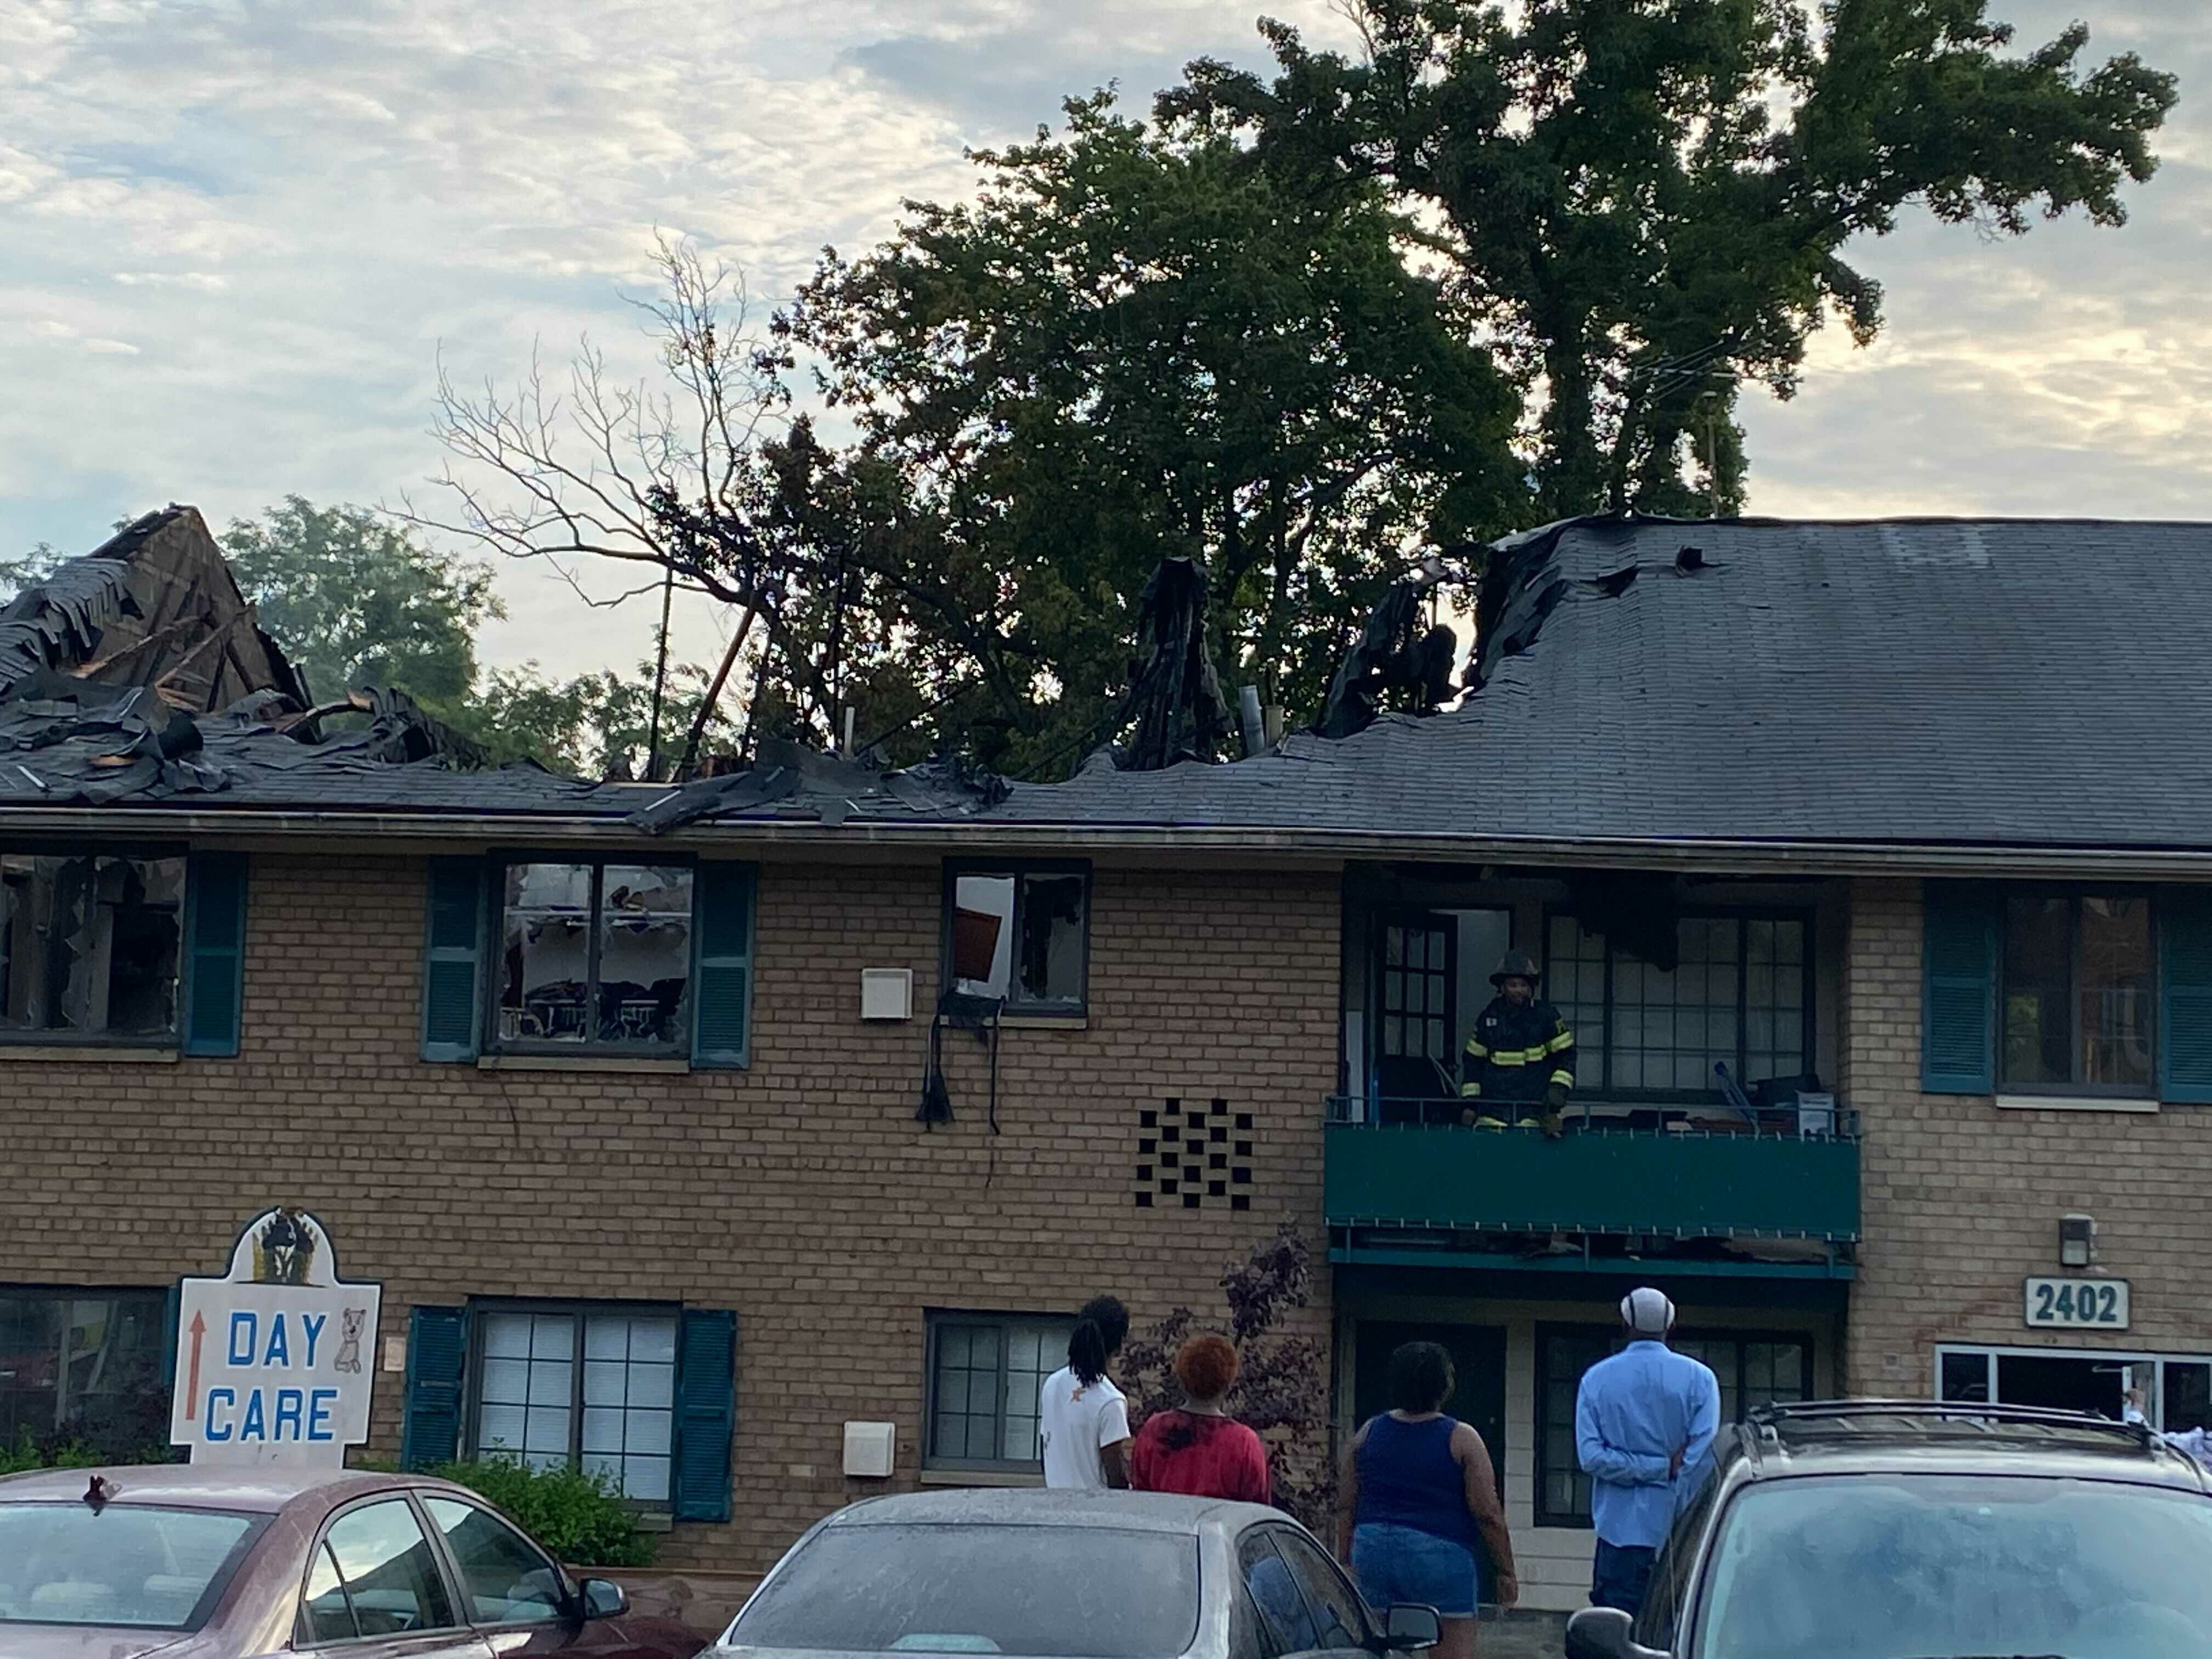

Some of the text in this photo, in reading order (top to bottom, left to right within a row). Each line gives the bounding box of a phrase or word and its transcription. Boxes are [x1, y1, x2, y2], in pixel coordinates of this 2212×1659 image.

[2036, 1284, 2117, 1321] 2402
[228, 1312, 326, 1367] DAY
[206, 1389, 338, 1441] CARE
